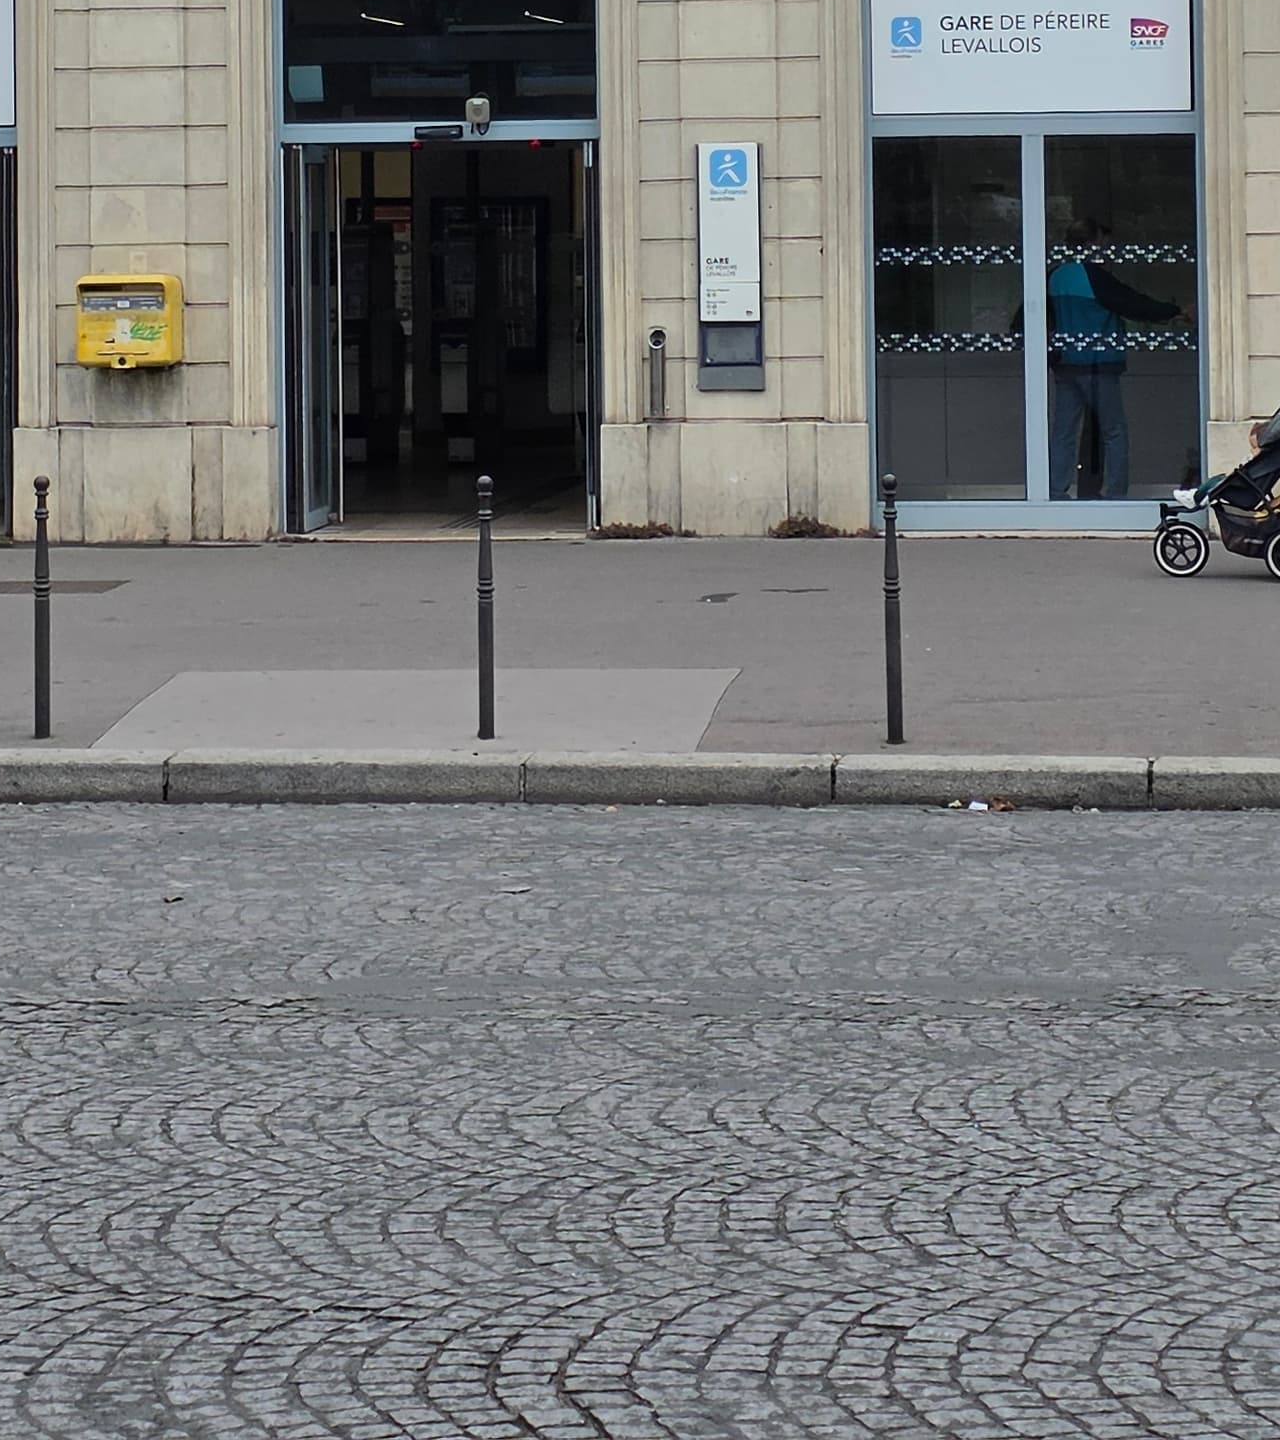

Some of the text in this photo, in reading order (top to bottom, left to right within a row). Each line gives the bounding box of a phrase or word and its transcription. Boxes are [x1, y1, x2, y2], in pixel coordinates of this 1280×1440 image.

[940, 10, 1111, 30] GARE DE PÉREIRE
[941, 37, 1042, 53] LEVALLOIS
